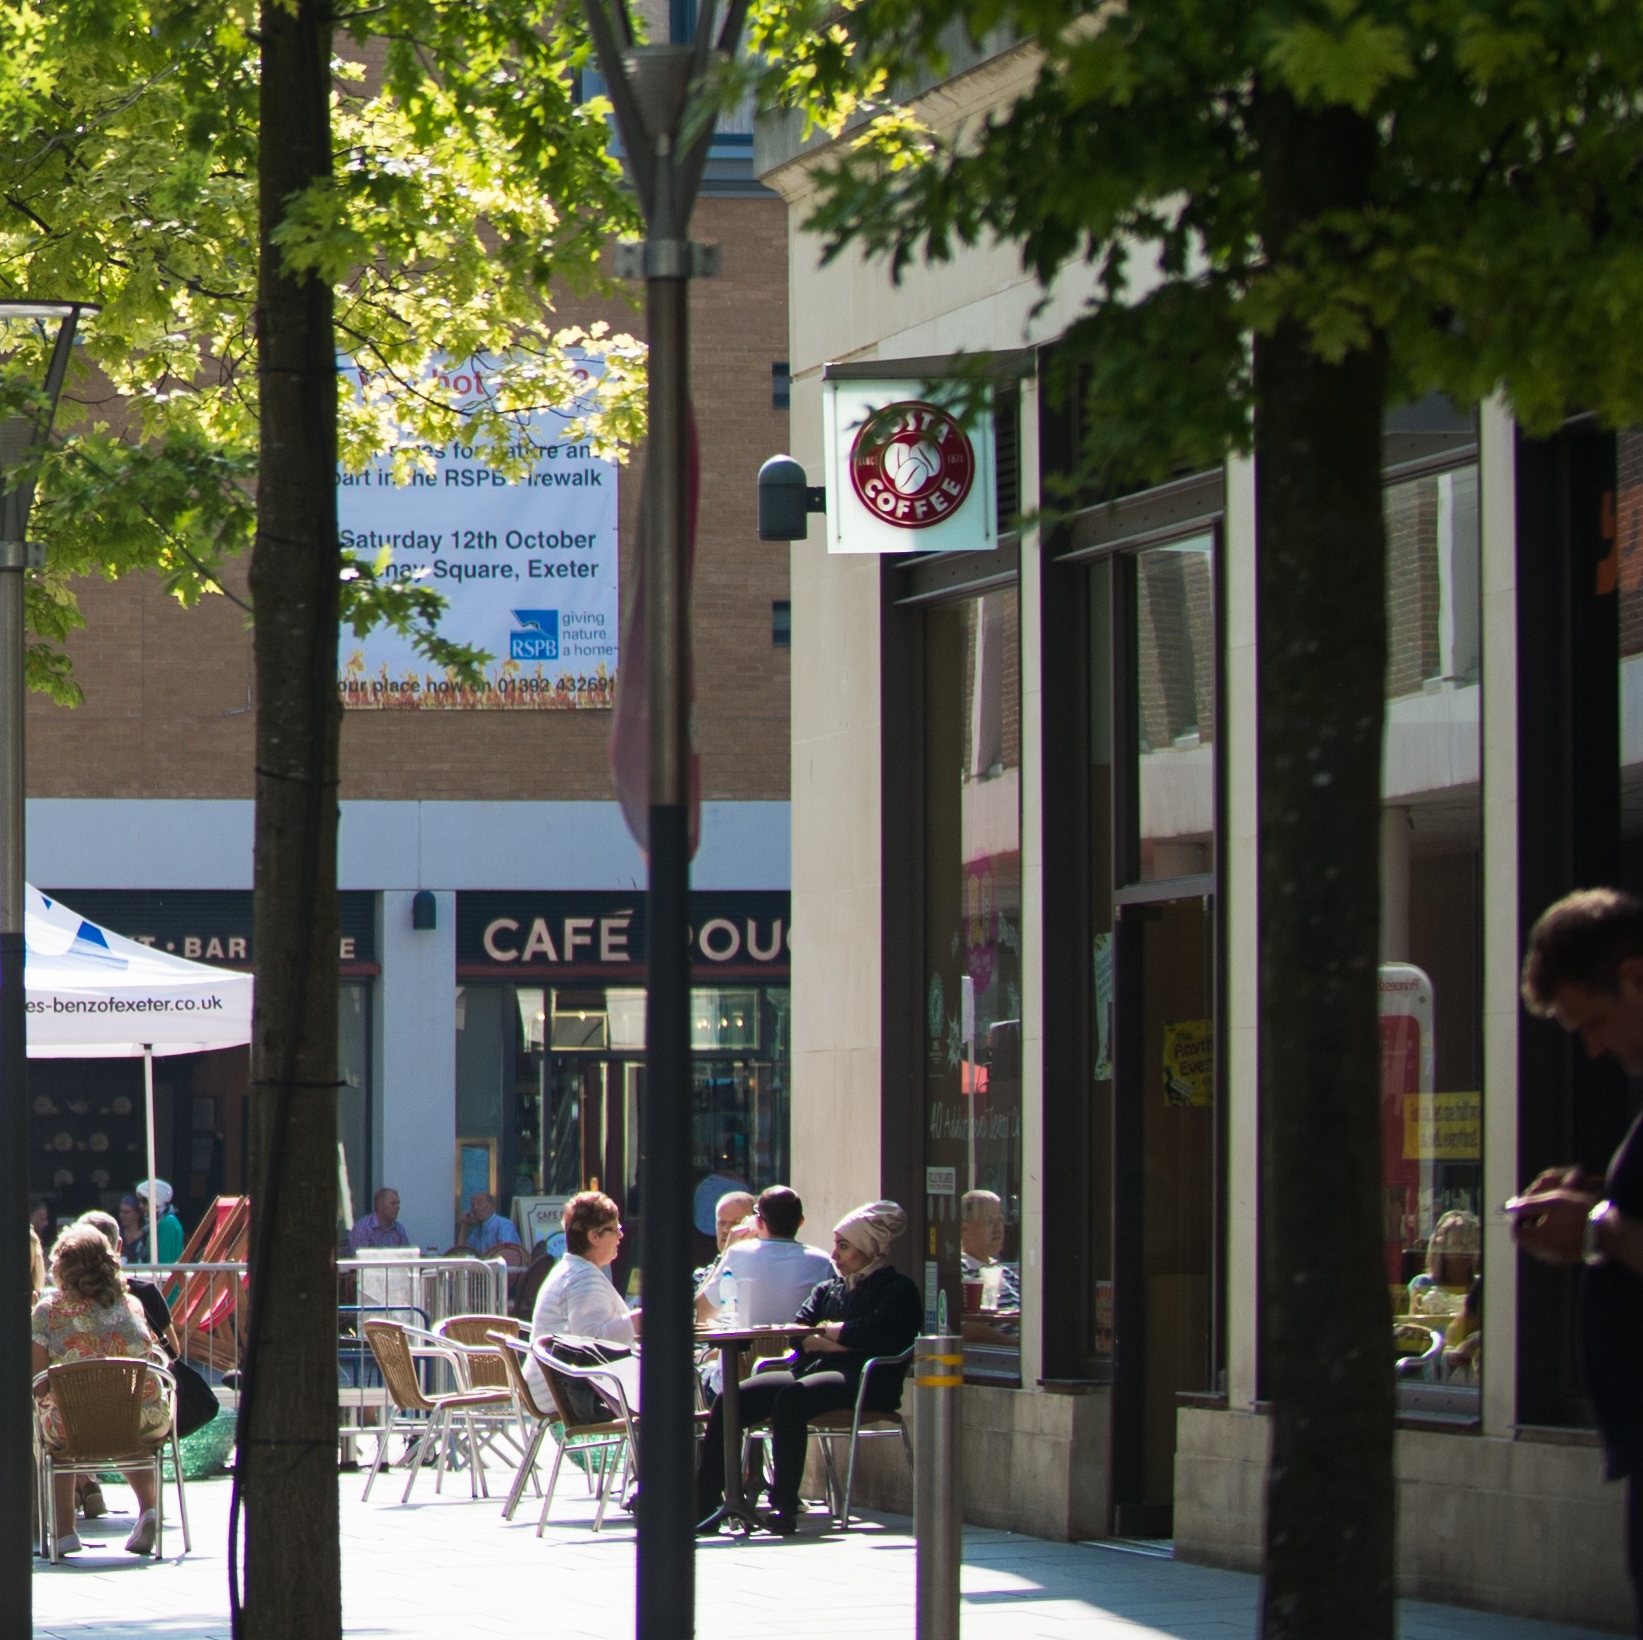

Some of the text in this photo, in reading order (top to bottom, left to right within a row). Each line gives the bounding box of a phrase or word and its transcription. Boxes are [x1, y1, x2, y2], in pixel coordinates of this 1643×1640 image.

[432, 369, 486, 395] hot
[453, 441, 478, 459] fo
[566, 443, 601, 459] an
[409, 469, 437, 486] he
[445, 469, 506, 487] RSPB
[515, 469, 602, 487] irewalk
[865, 477, 961, 519] COFFEE
[340, 530, 597, 554] Saturday 12th October
[433, 560, 520, 584] Square,
[528, 560, 599, 579] Exeter
[562, 612, 605, 627] giving
[562, 628, 607, 641] nature
[511, 639, 558, 658] RSPB
[562, 644, 614, 657] a home
[337, 680, 366, 693] our
[373, 678, 421, 696] place
[427, 680, 463, 693] now
[498, 677, 550, 693] 01392
[555, 677, 616, 693] 432691
[483, 909, 635, 962] CAFÉ
[184, 936, 247, 959] BAR
